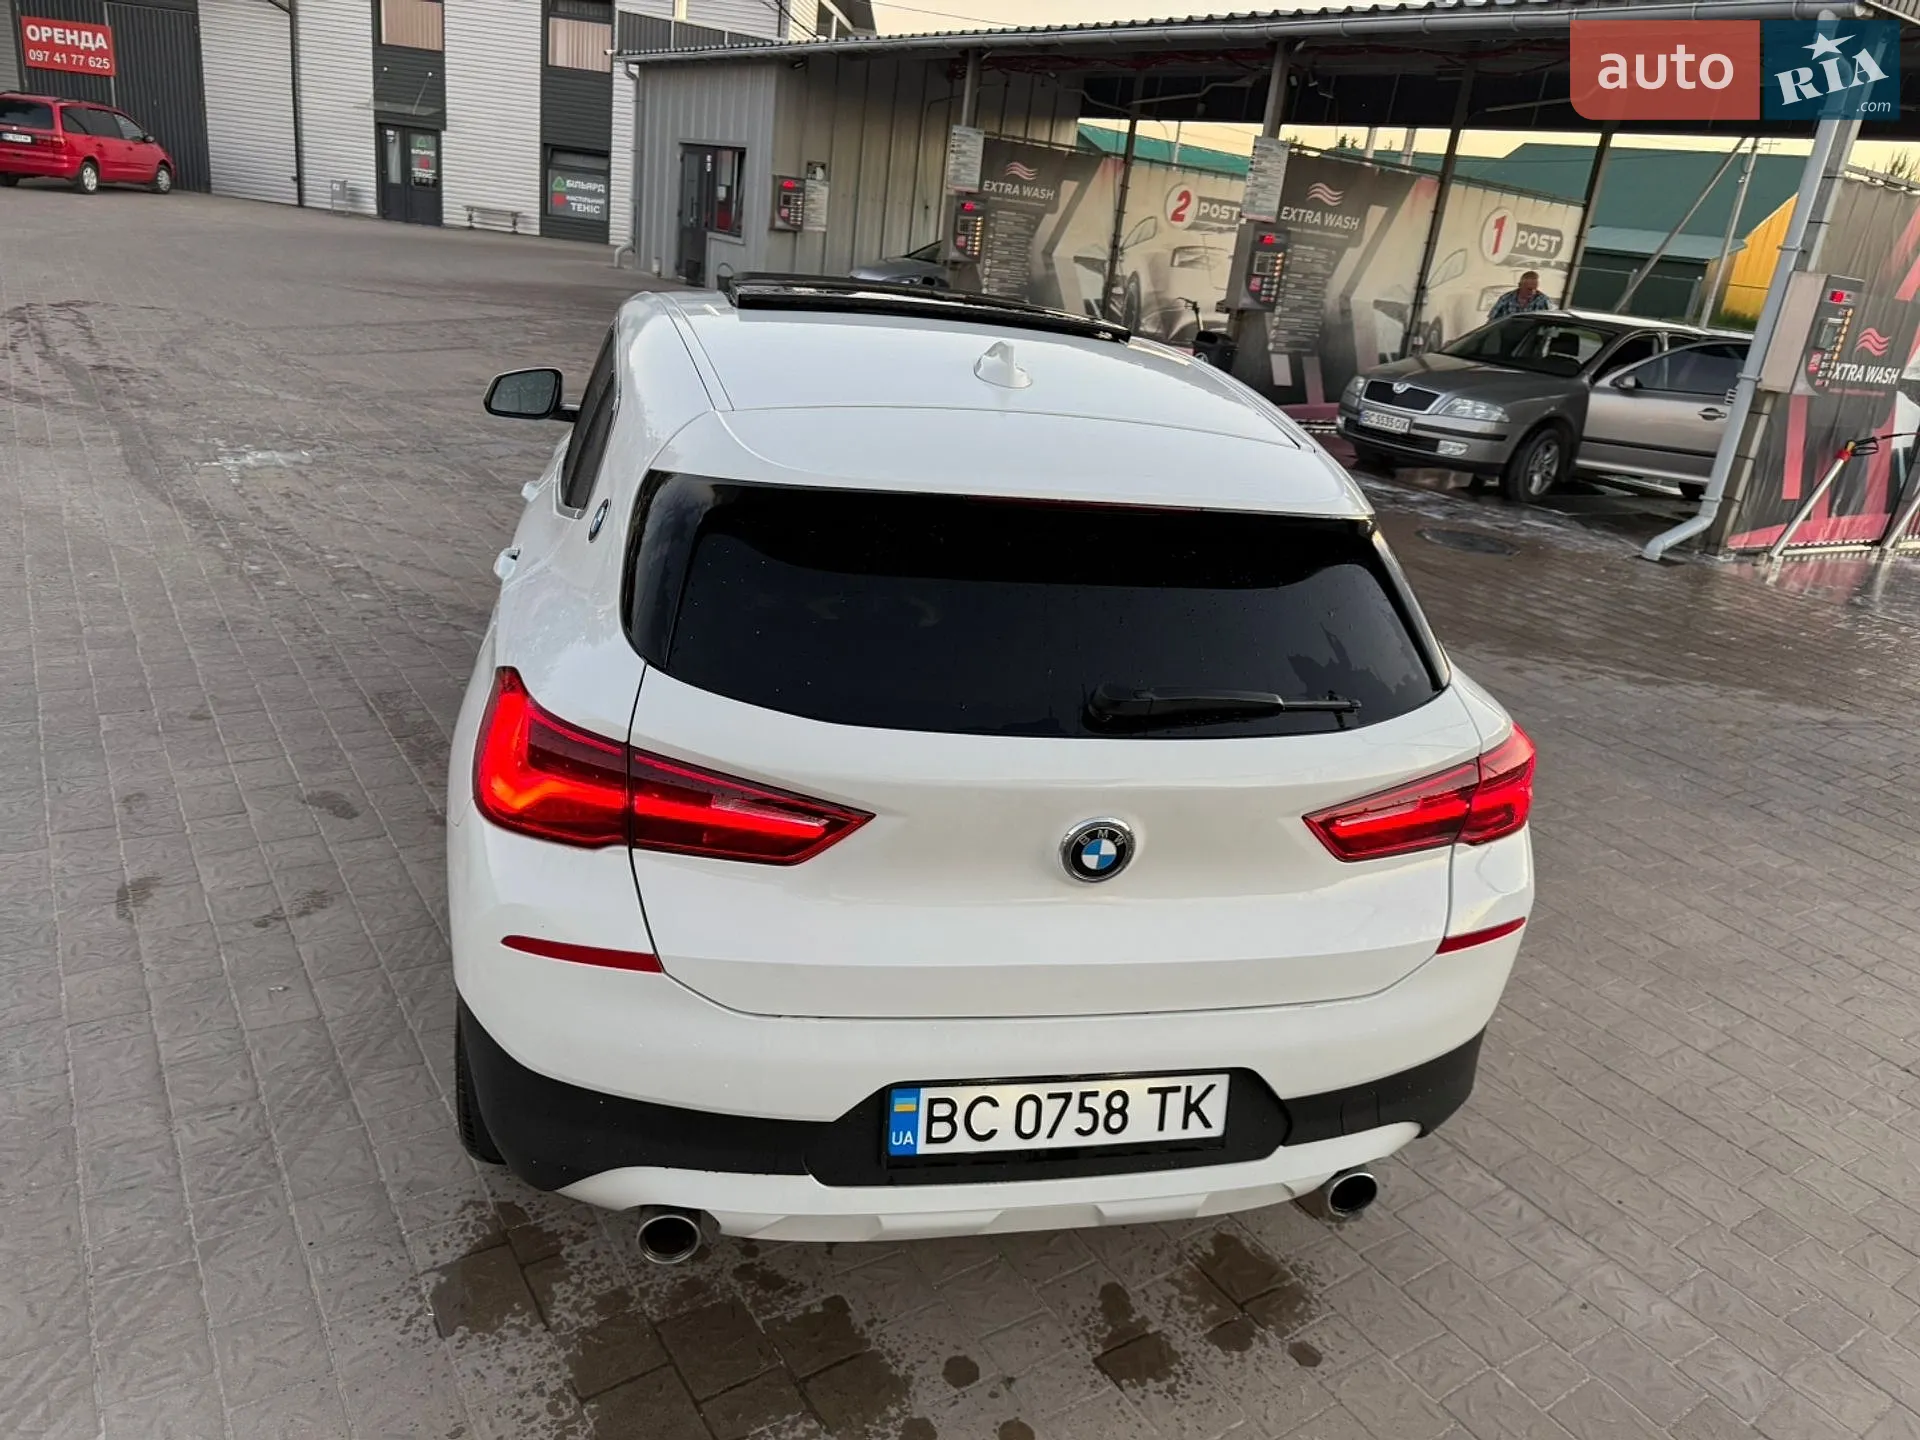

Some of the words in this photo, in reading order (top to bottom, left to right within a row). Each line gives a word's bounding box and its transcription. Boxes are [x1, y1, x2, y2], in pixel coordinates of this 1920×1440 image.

[26, 24, 108, 51] ОРЕНДА
[28, 48, 49, 62] 097
[53, 52, 67, 64] 41
[71, 54, 85, 66] 77
[88, 56, 111, 69] 625
[983, 180, 1020, 196] EXTRA
[1022, 184, 1055, 200] WASH
[570, 202, 601, 214] ТЕНІС
[1170, 190, 1191, 223] 2
[1199, 202, 1240, 221] POST
[1280, 206, 1321, 225] EXTRA
[1323, 212, 1360, 232] WASH
[1492, 215, 1507, 255] 1
[1515, 230, 1561, 253] POST
[1831, 362, 1862, 381] XTRA
[1864, 365, 1900, 384] WASH
[925, 1095, 999, 1145] BC
[1014, 1089, 1129, 1140] 0758
[1147, 1083, 1217, 1132] TK
[891, 1130, 915, 1146] UA
